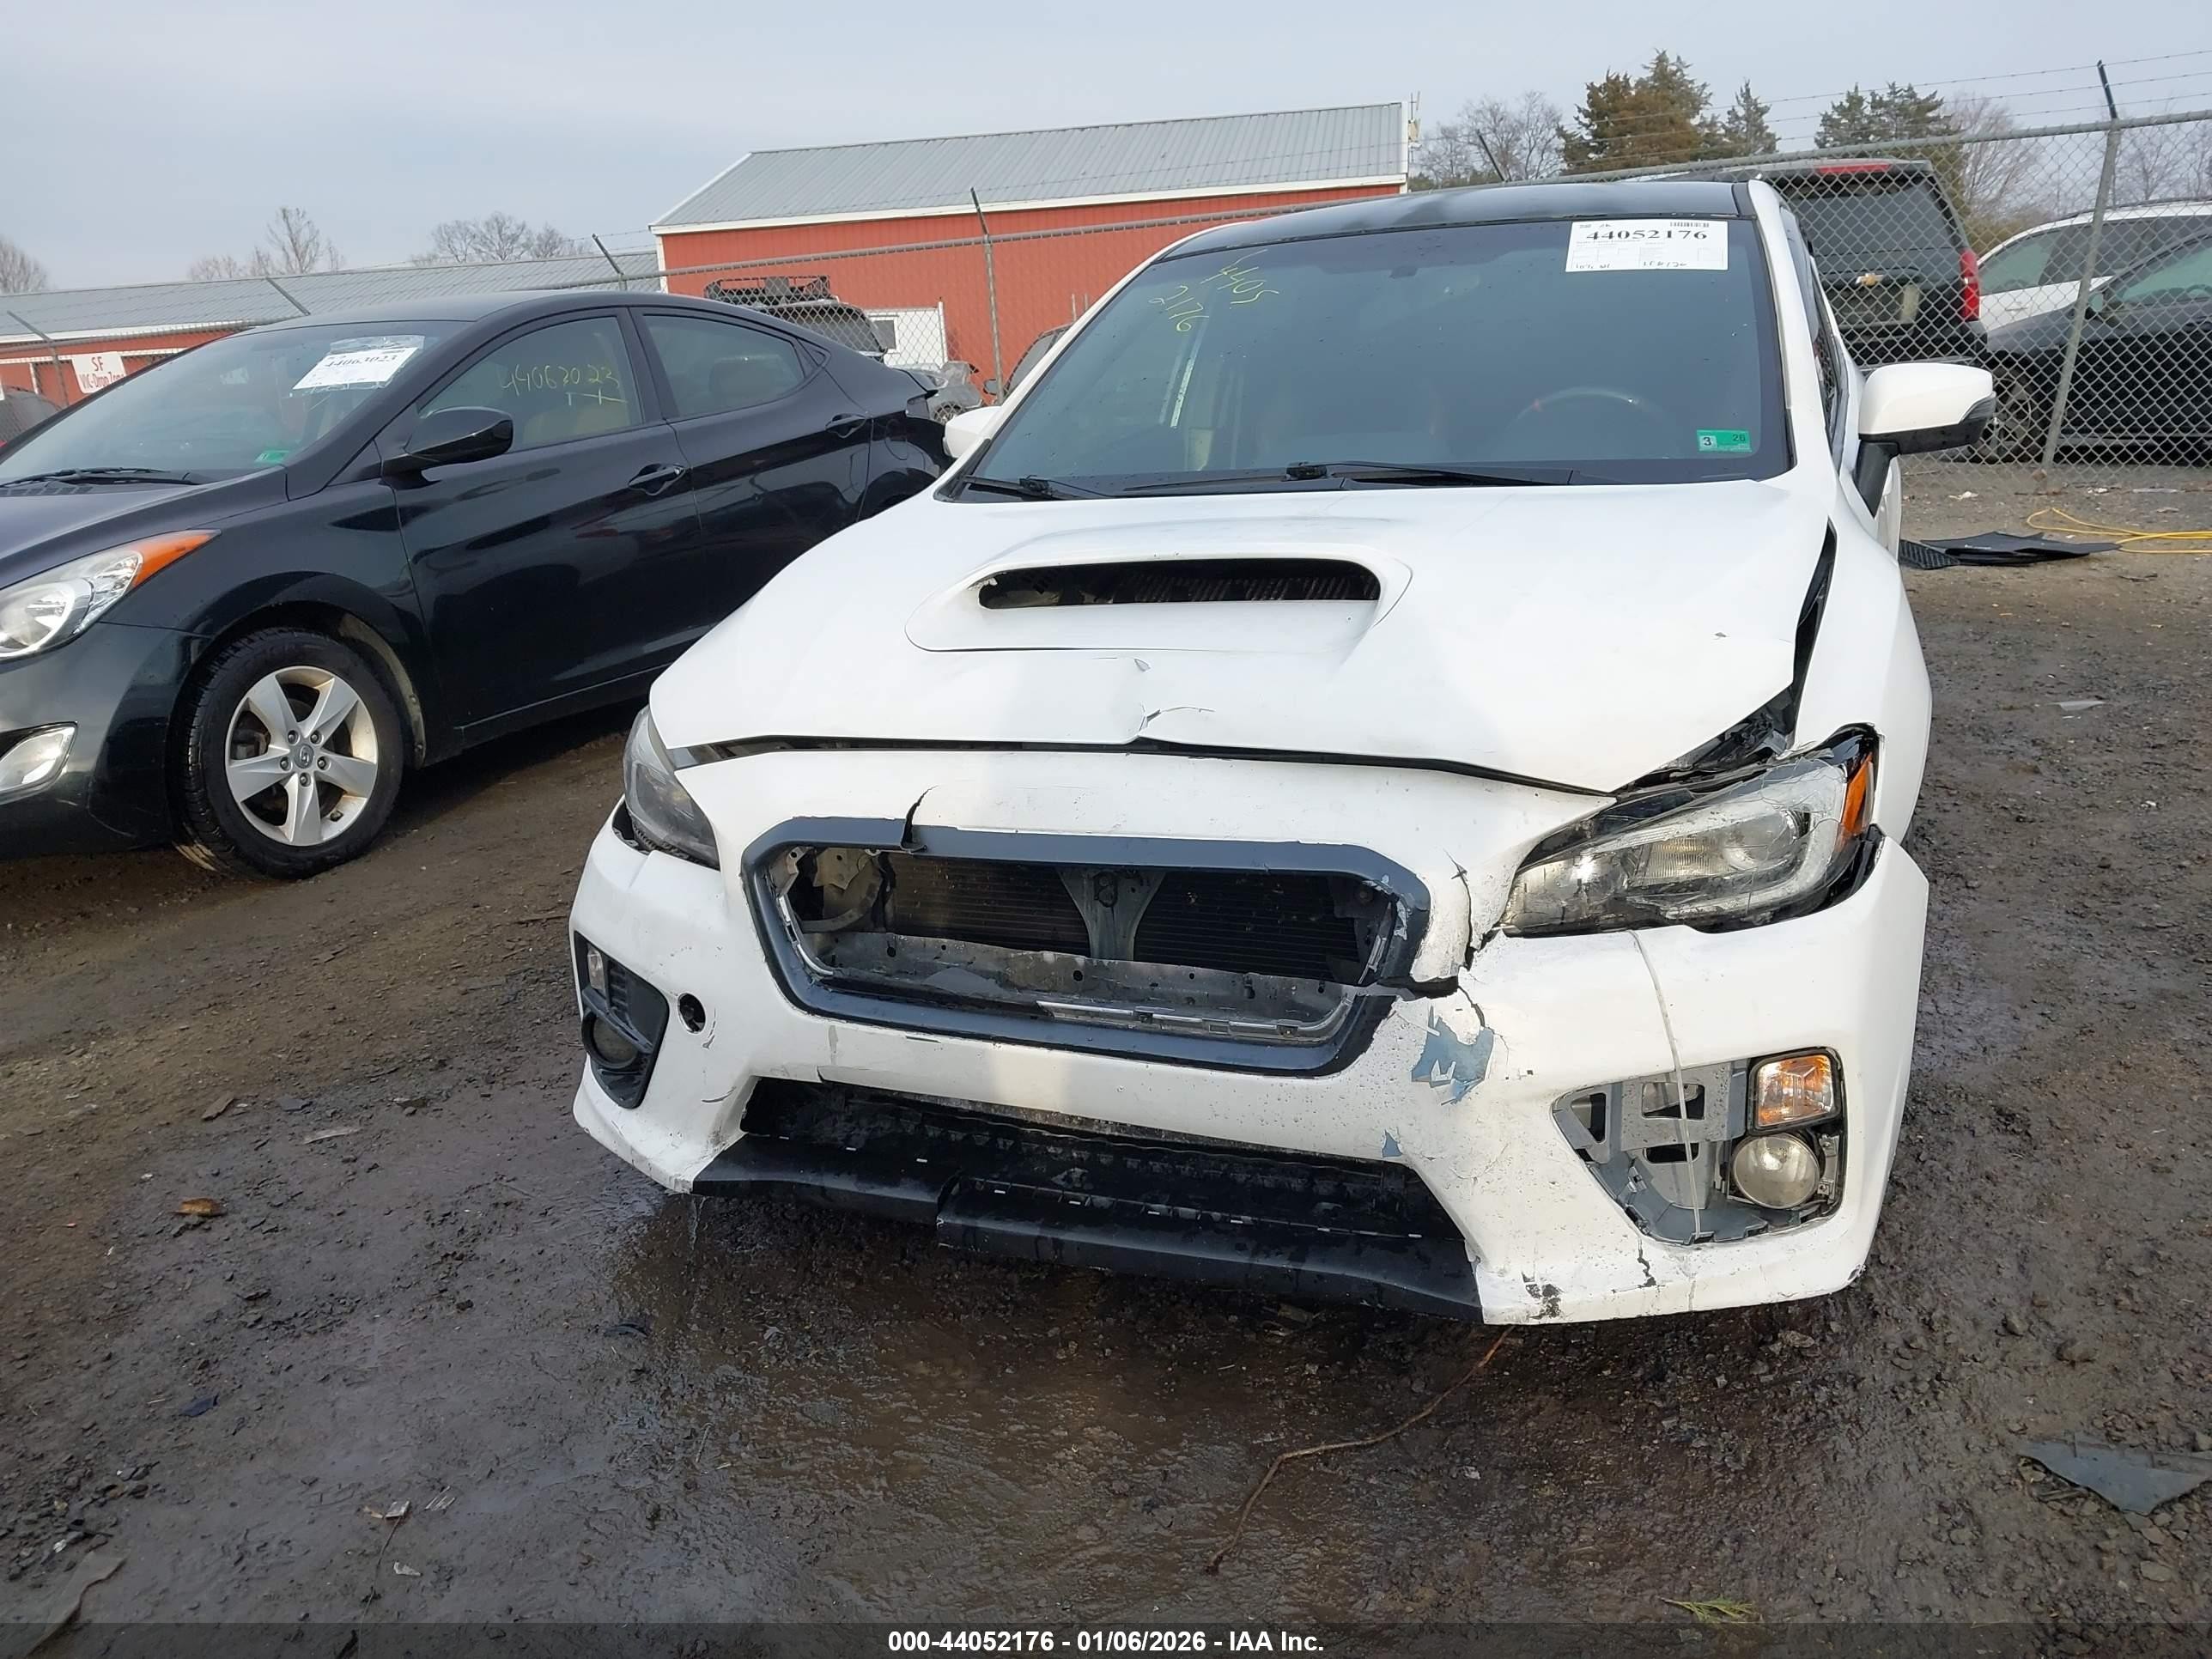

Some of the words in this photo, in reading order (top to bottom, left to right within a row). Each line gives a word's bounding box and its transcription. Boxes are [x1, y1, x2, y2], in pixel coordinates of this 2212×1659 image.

[1586, 229, 1708, 240] 44052176
[91, 356, 104, 371] SF
[501, 364, 620, 397] 44063023
[1703, 436, 1712, 446] 3
